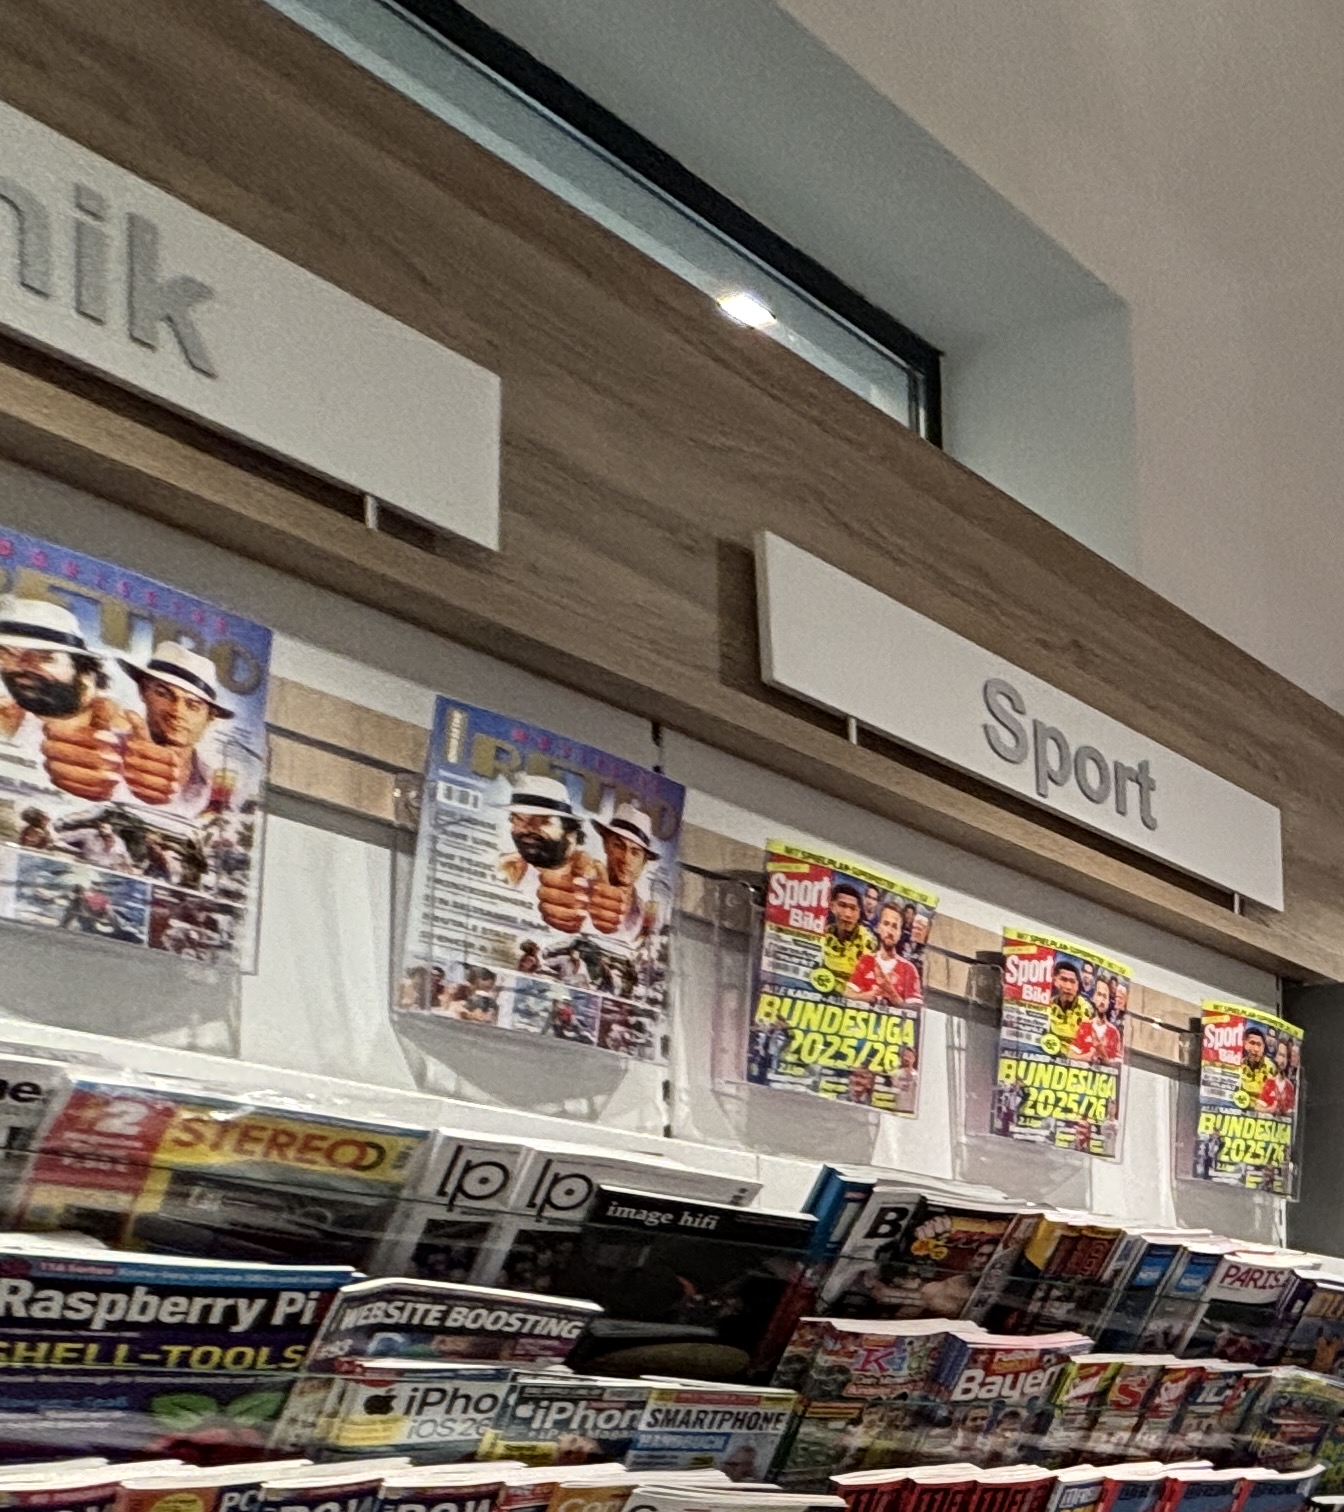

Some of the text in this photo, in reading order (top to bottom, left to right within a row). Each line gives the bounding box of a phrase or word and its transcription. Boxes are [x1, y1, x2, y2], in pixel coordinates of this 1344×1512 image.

[982, 677, 1158, 831] Sport
[768, 871, 831, 908] Sport
[755, 994, 916, 1048] BUNDESLIGA
[604, 1199, 720, 1231] image hifi
[0, 1278, 317, 1334] Raspberry Pi
[446, 1305, 585, 1340] BOOSTING
[645, 1406, 787, 1431] SMARTPHONE
